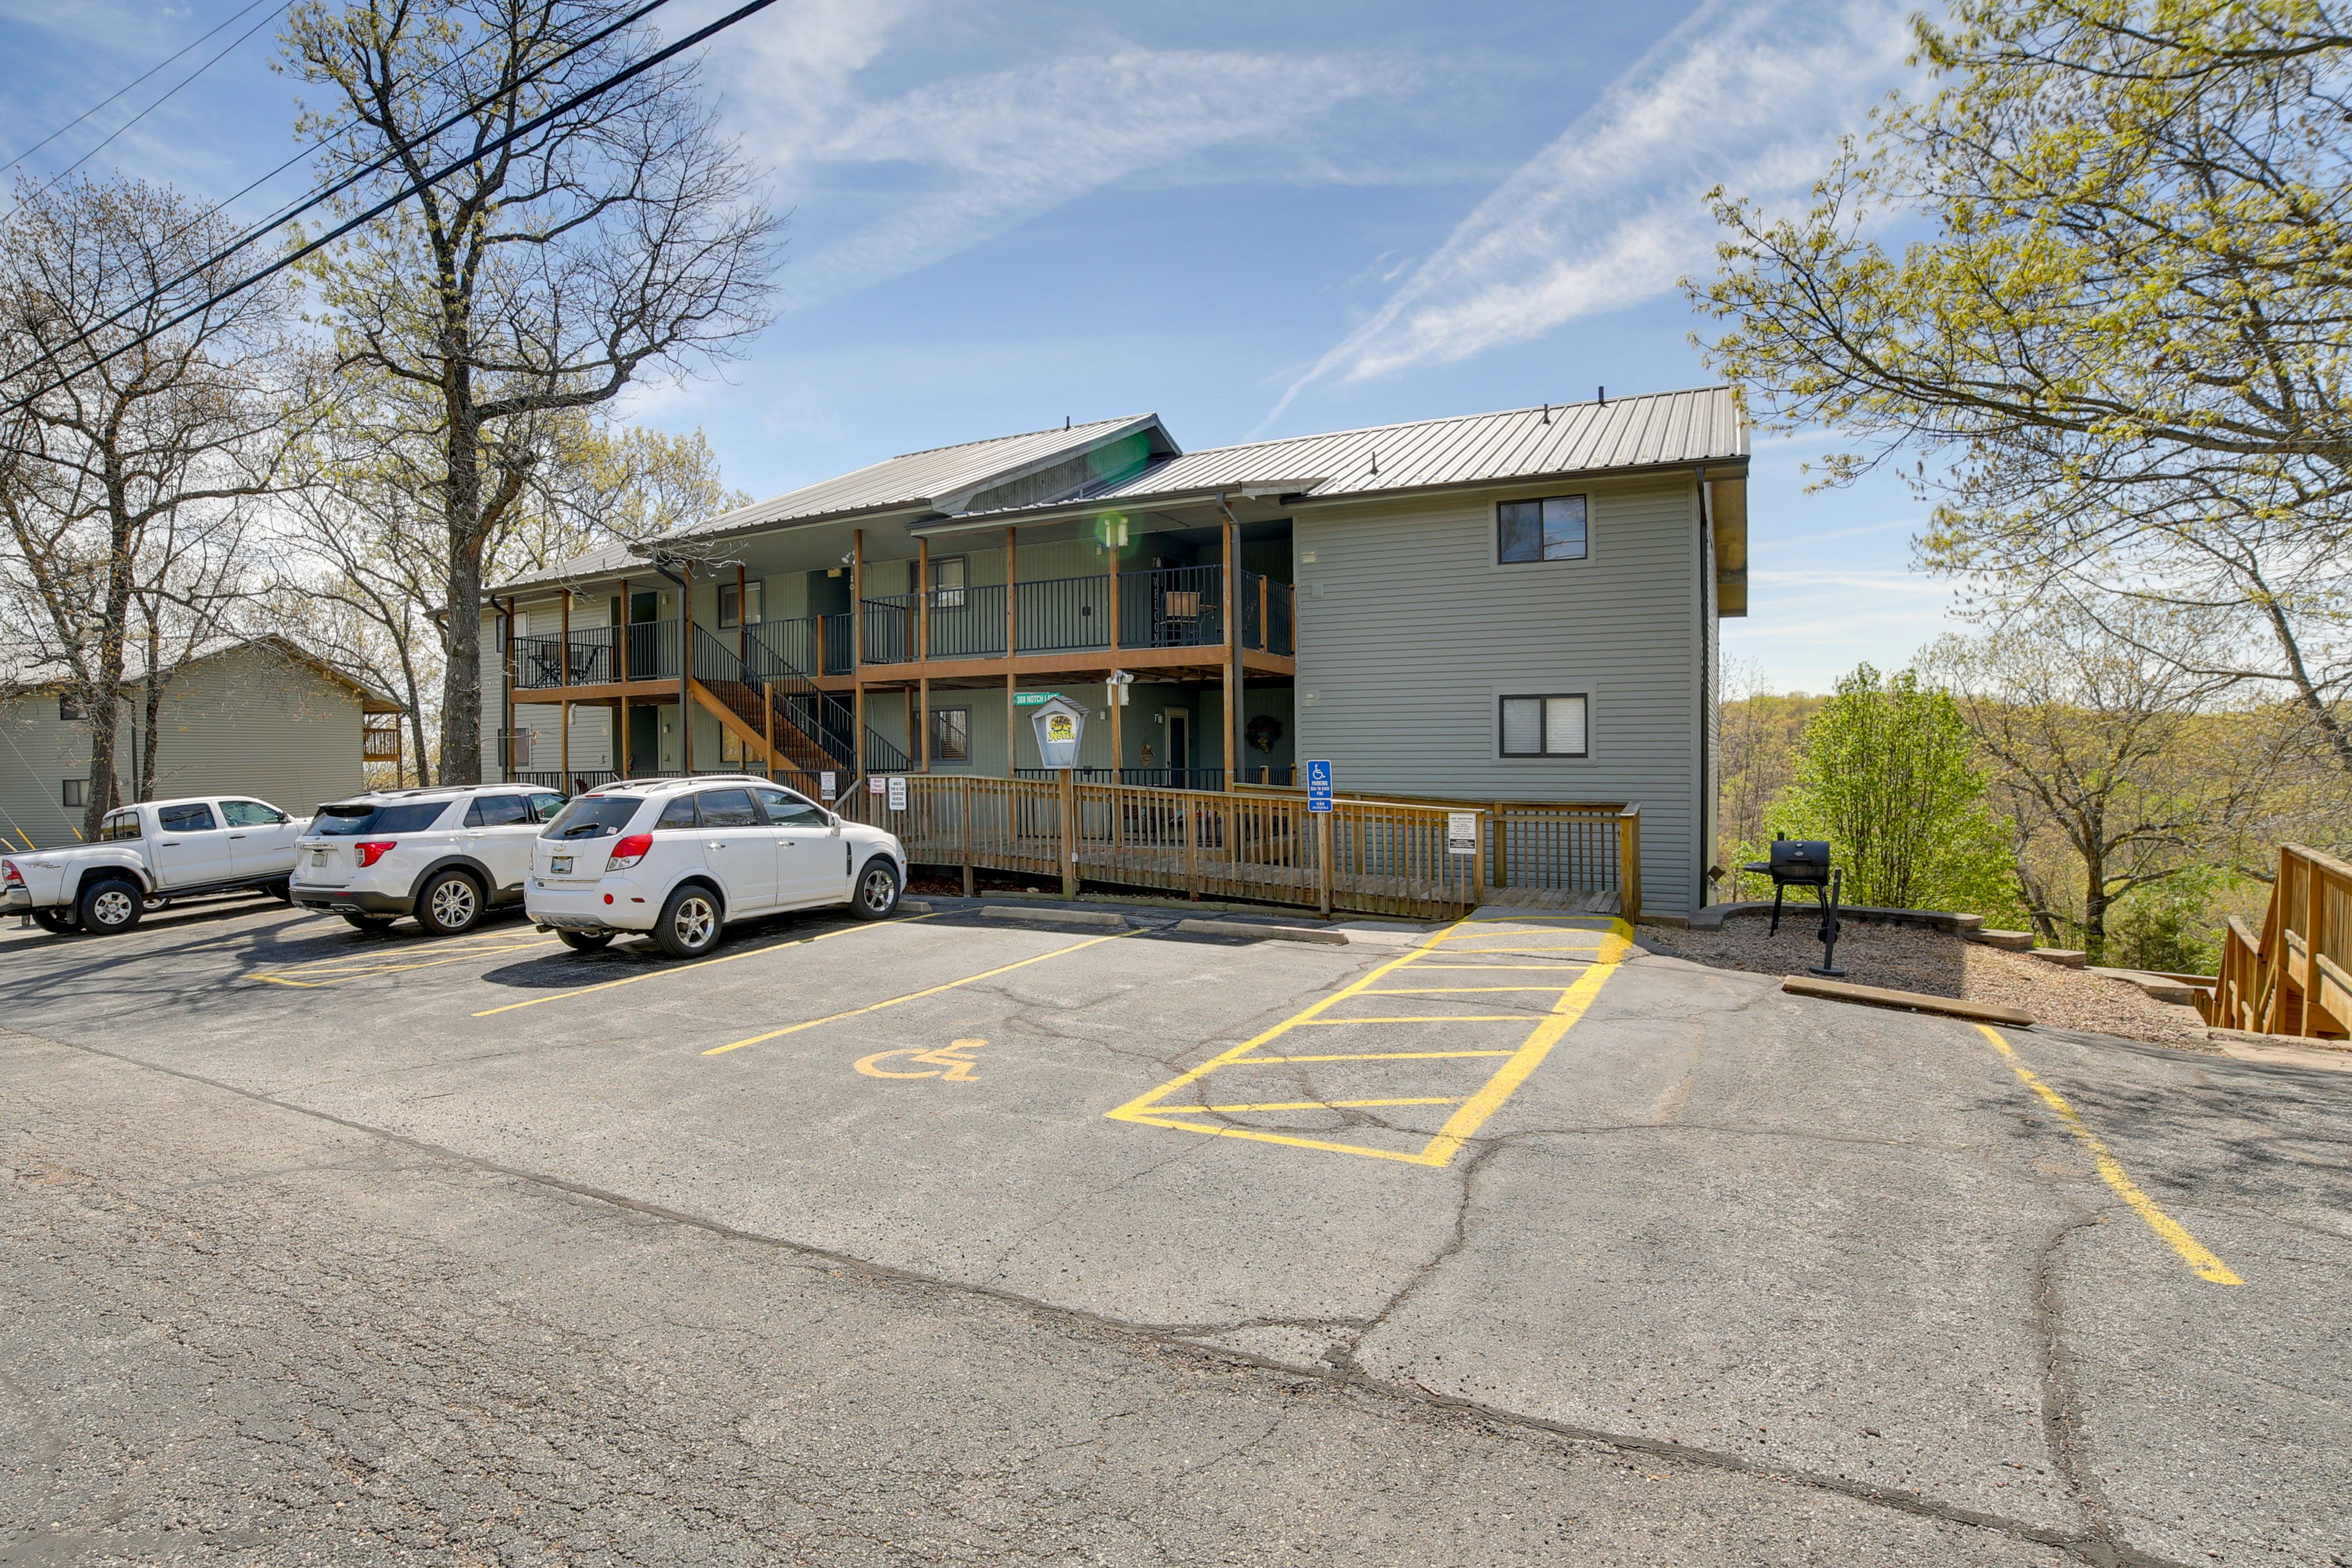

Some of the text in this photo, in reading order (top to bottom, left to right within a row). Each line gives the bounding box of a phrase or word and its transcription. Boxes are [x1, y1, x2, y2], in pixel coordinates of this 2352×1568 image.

[850, 575, 854, 590] 10
[1017, 695, 1026, 704] 388
[1027, 695, 1044, 703] NOTCH
[1048, 730, 1076, 742] Notch
